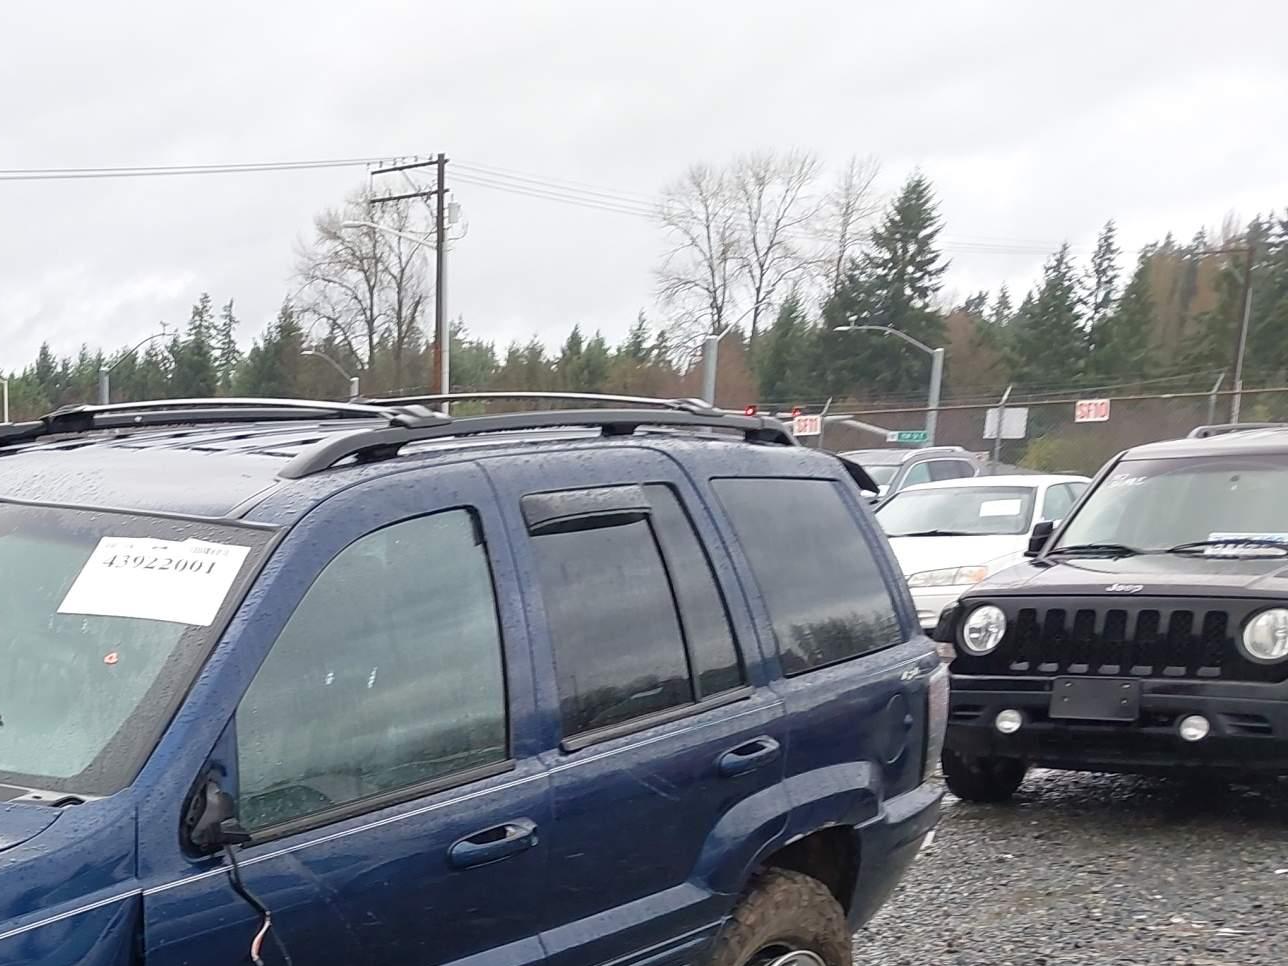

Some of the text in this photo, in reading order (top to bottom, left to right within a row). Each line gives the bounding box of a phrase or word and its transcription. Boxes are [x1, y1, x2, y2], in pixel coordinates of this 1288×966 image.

[1079, 402, 1108, 419] SF10
[102, 554, 217, 575] 43922001
[1105, 583, 1145, 595] Jeep
